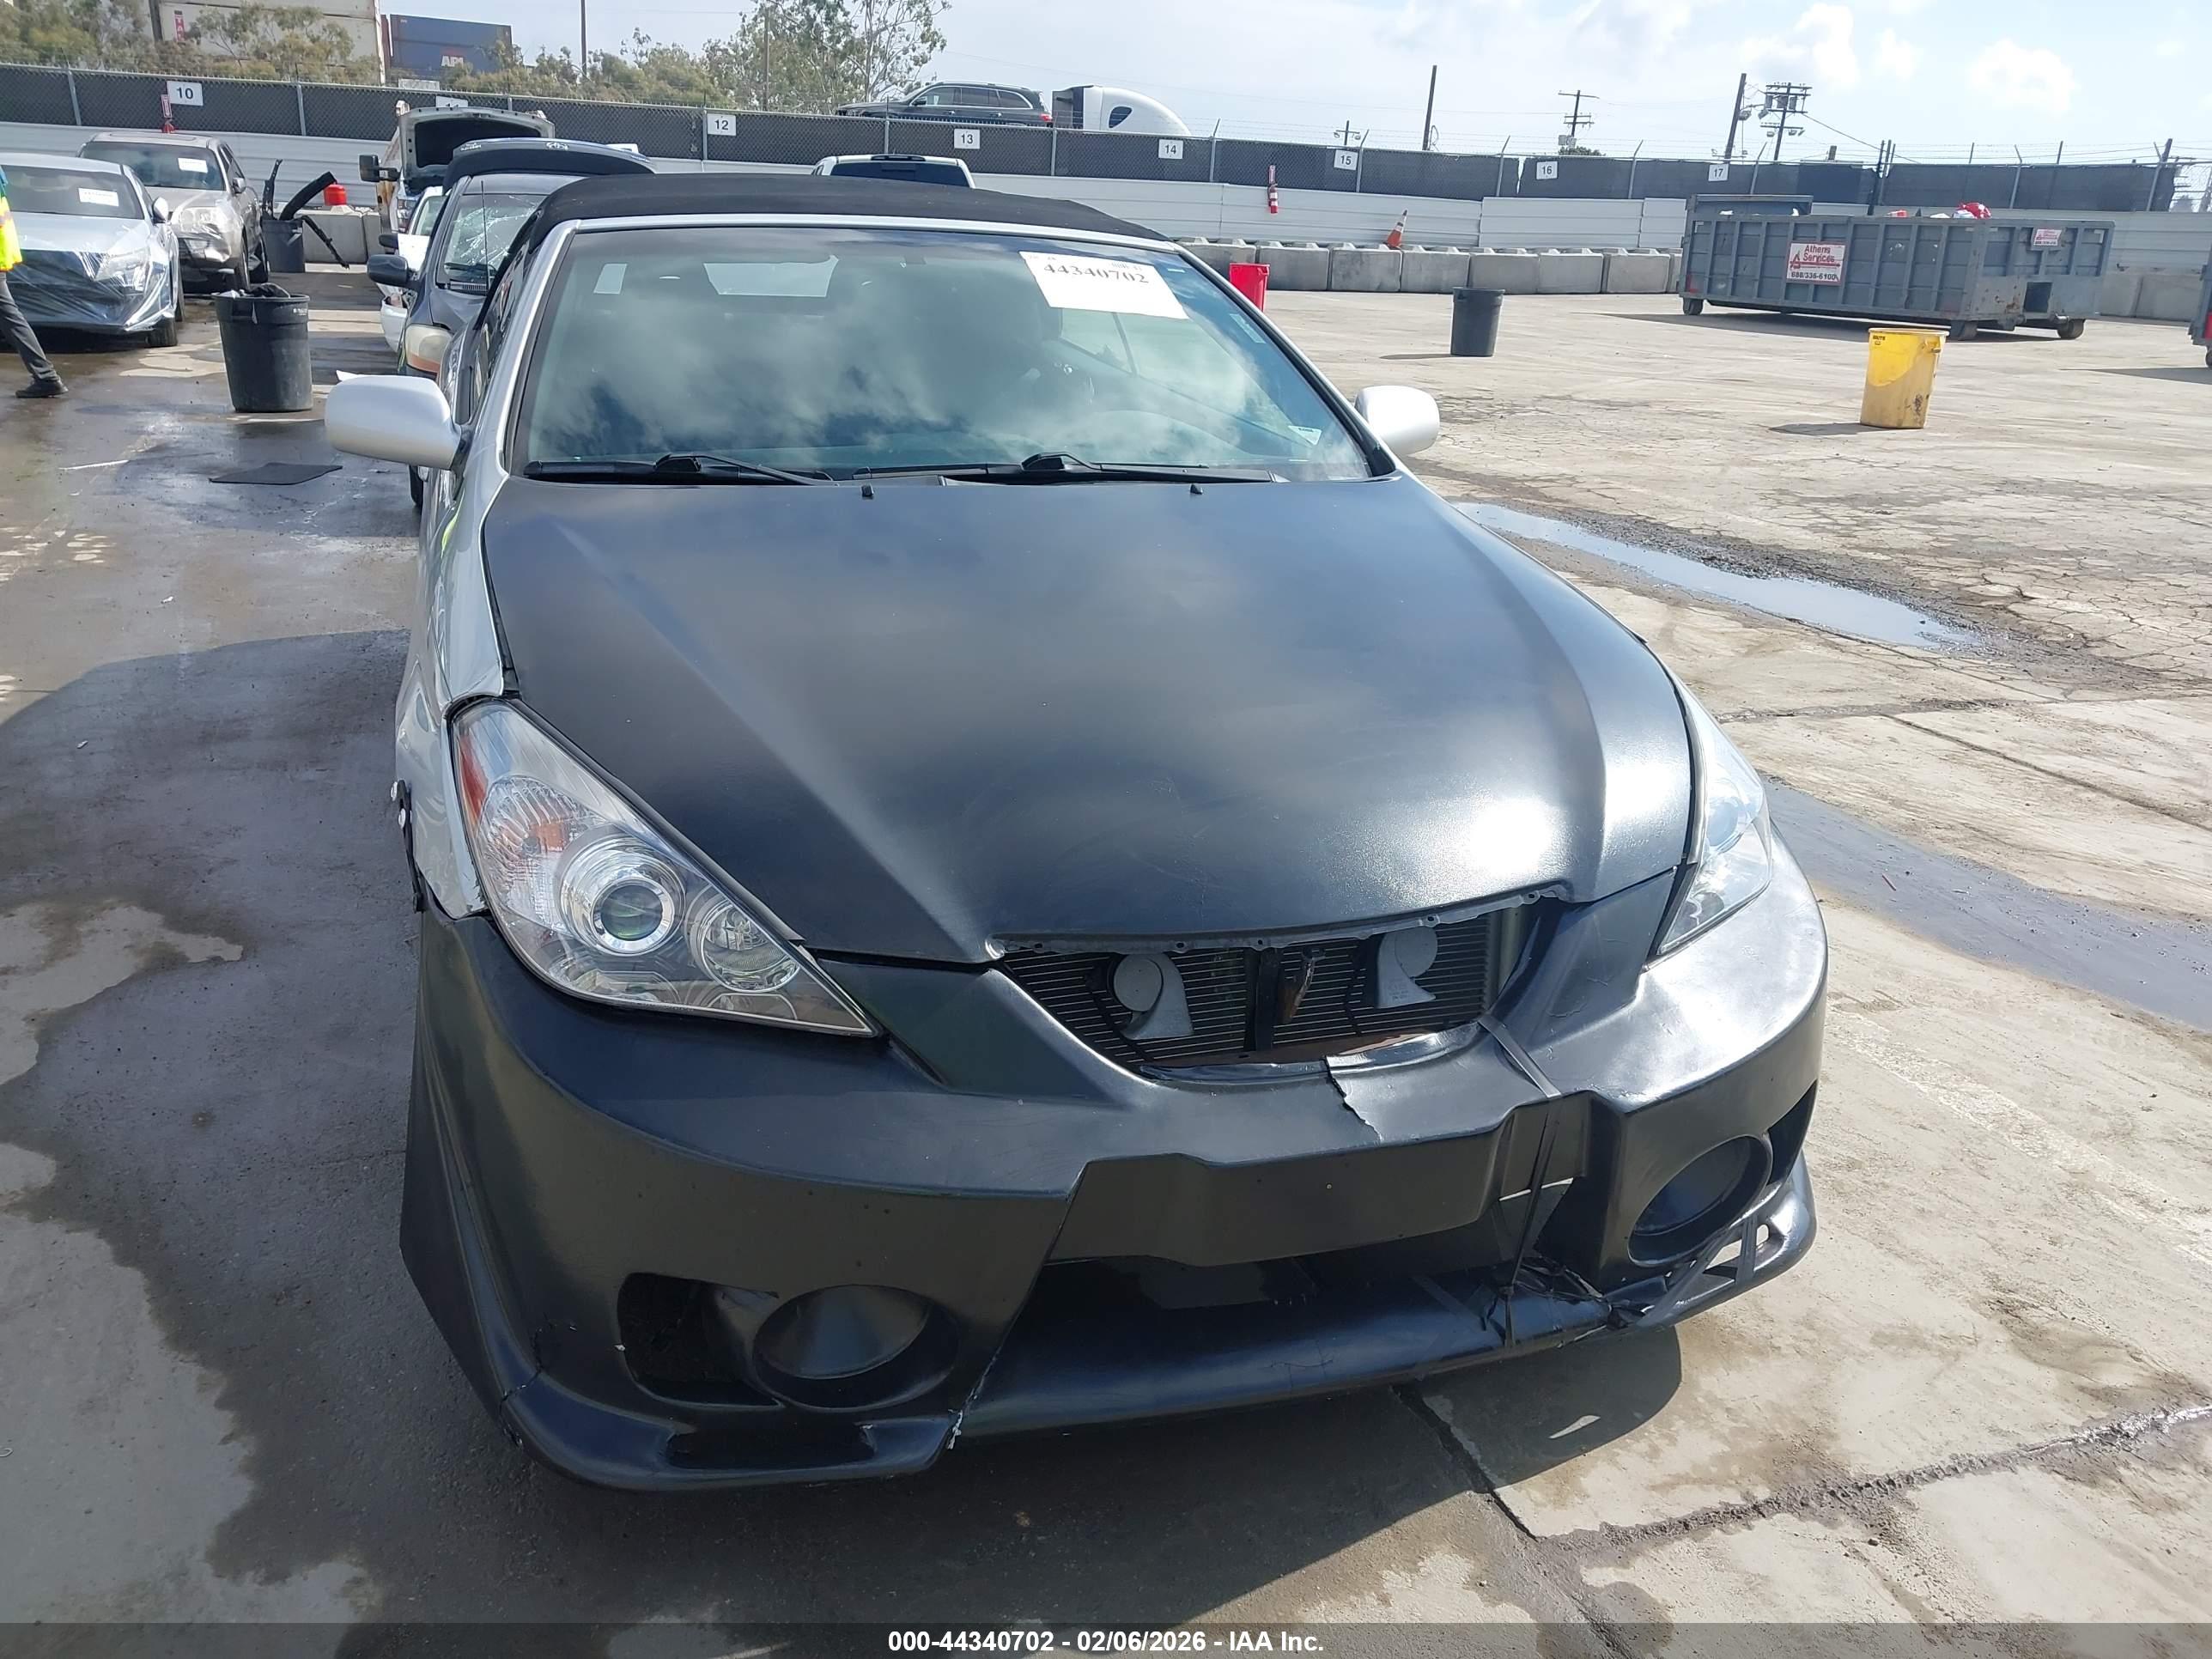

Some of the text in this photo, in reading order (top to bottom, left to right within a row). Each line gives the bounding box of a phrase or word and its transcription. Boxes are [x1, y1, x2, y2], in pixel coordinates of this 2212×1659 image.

[176, 87, 194, 100] 10
[714, 118, 729, 131] 12
[960, 133, 974, 144] 13
[1164, 144, 1176, 155] 14
[1340, 155, 1352, 166] 15
[1542, 165, 1553, 175] 16
[1714, 168, 1724, 179] 17
[1804, 245, 1831, 253] Athens
[1802, 252, 1835, 263] Services
[1043, 263, 1150, 284] 44340702
